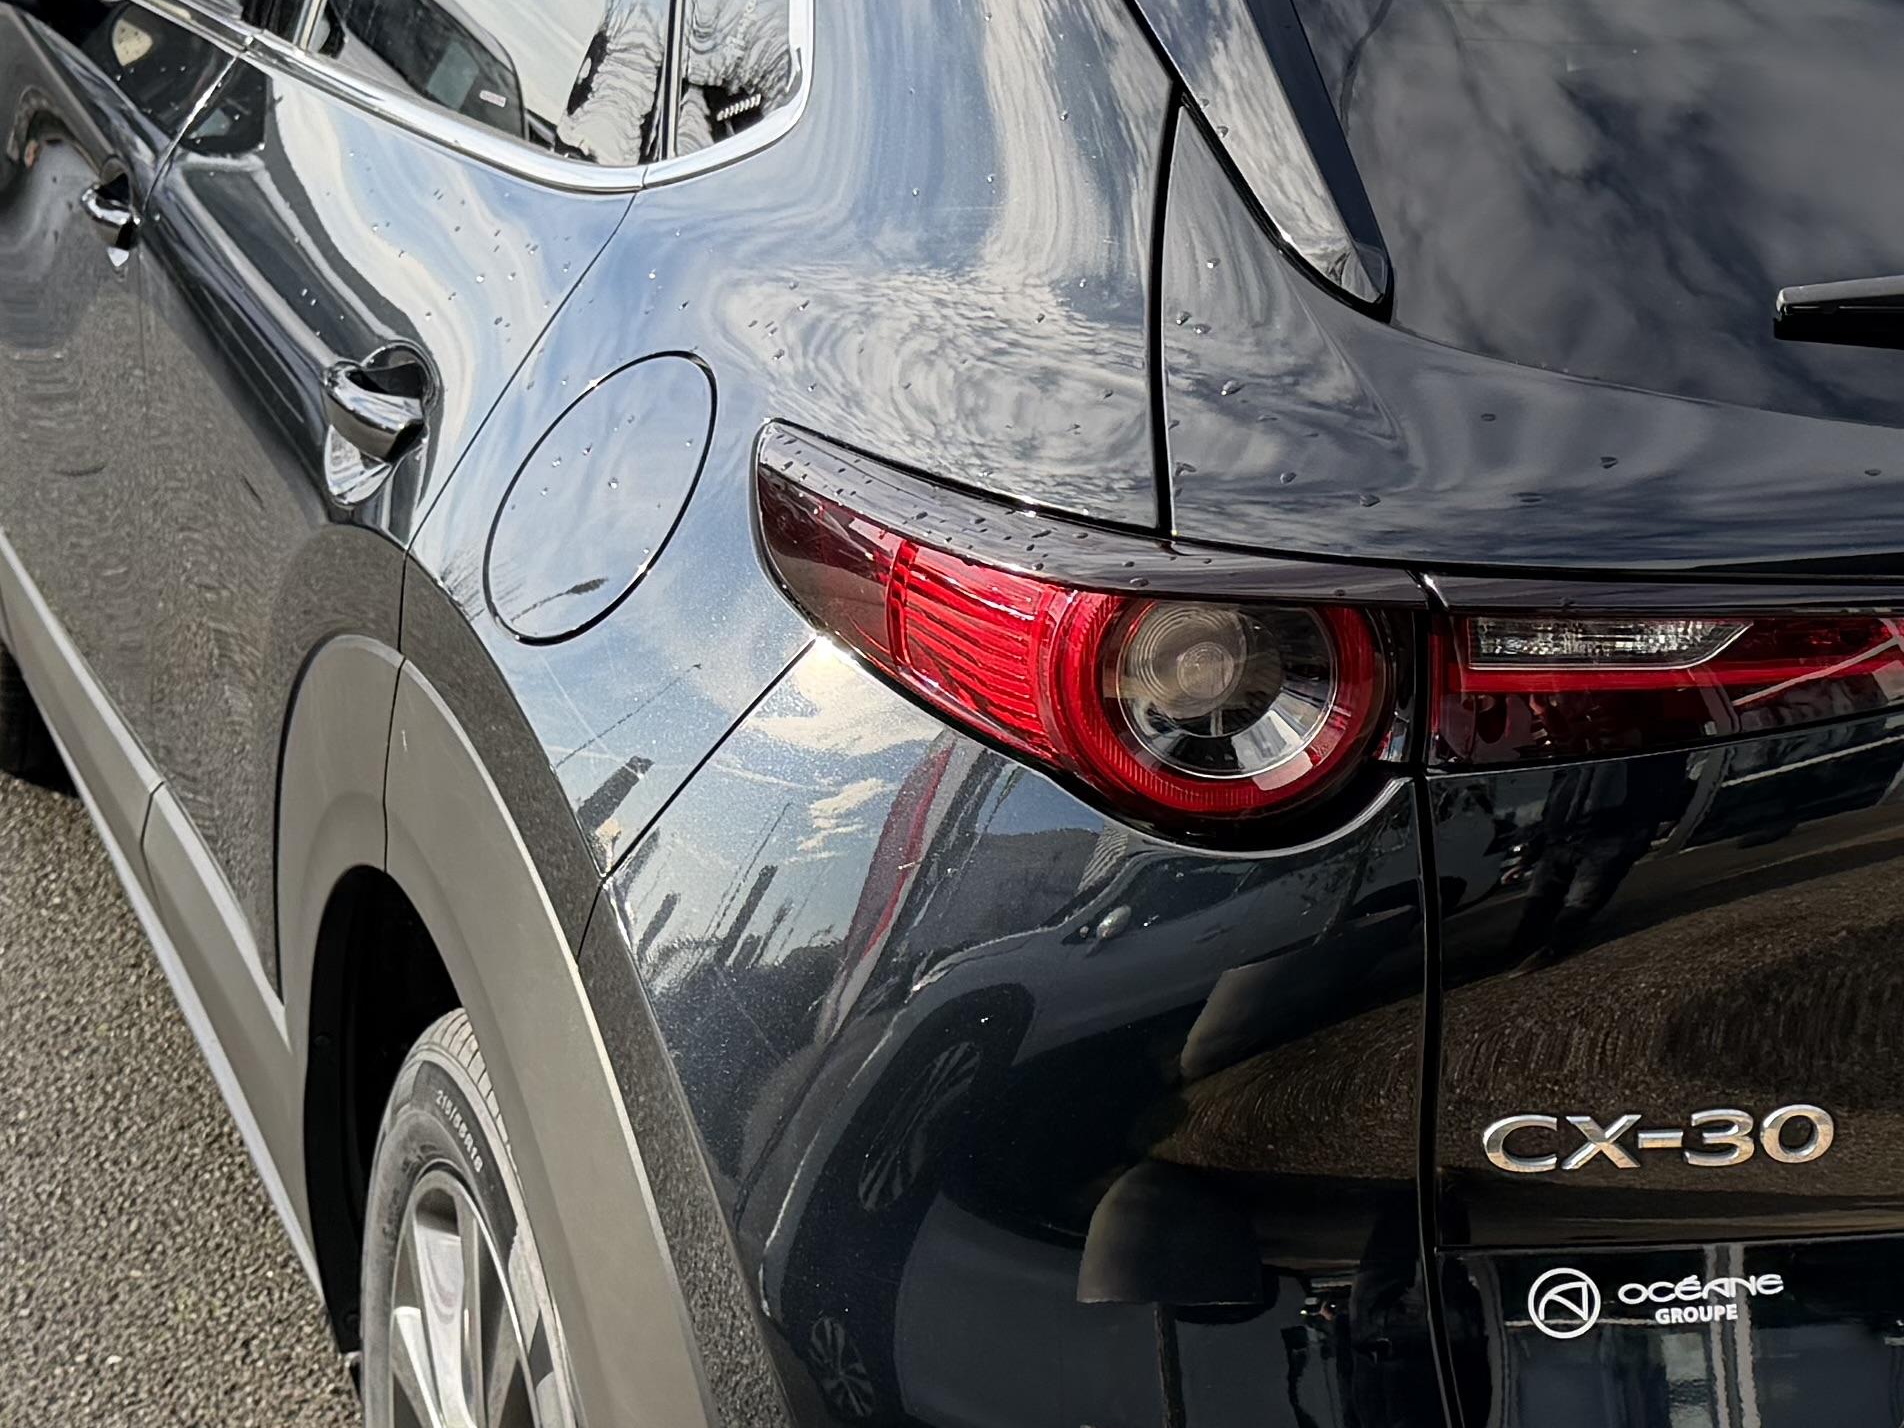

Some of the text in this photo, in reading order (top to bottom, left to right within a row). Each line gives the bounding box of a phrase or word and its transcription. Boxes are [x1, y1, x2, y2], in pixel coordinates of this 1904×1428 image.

[1483, 1103, 1834, 1172] CX-30
[1617, 1274, 1784, 1305] OCÉANE
[1655, 1303, 1738, 1325] GROUPE
